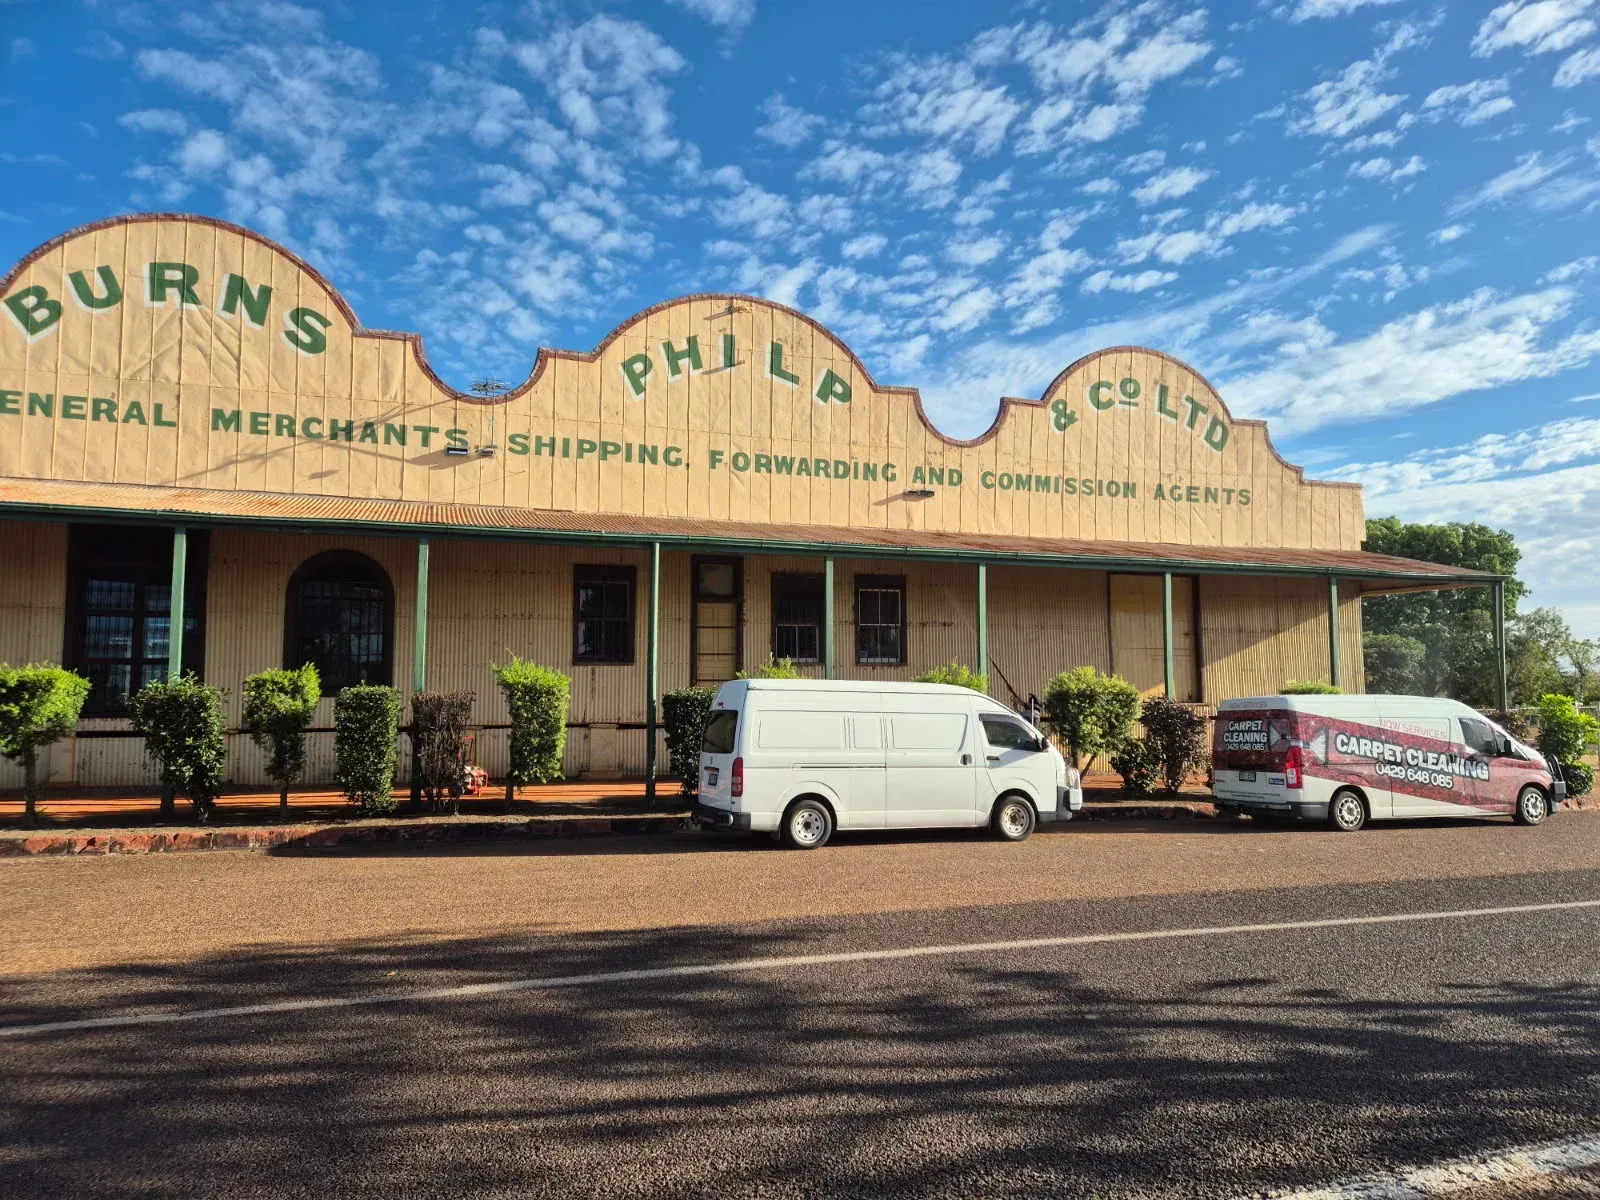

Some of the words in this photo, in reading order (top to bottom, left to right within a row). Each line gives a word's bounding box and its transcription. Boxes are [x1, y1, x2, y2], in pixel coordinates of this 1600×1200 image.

[4, 262, 333, 356] BURNS
[620, 334, 852, 404] PHILP
[1051, 399, 1079, 432] &
[1156, 383, 1230, 453] LTD
[508, 433, 690, 471] SHIPPING,
[709, 449, 897, 482] FORWARDING
[912, 466, 963, 487] AND
[981, 470, 1137, 499] COMMISSION
[1153, 482, 1251, 506] AGENTS
[1223, 732, 1268, 743] CLEANING
[1228, 720, 1263, 731] CARPET
[1402, 723, 1446, 738] SERVICES
[1336, 734, 1402, 763] CARPET
[1406, 749, 1489, 780] CLEANING
[1376, 762, 1405, 778] 0429
[1407, 768, 1430, 783] 648
[1431, 773, 1453, 788] 085
